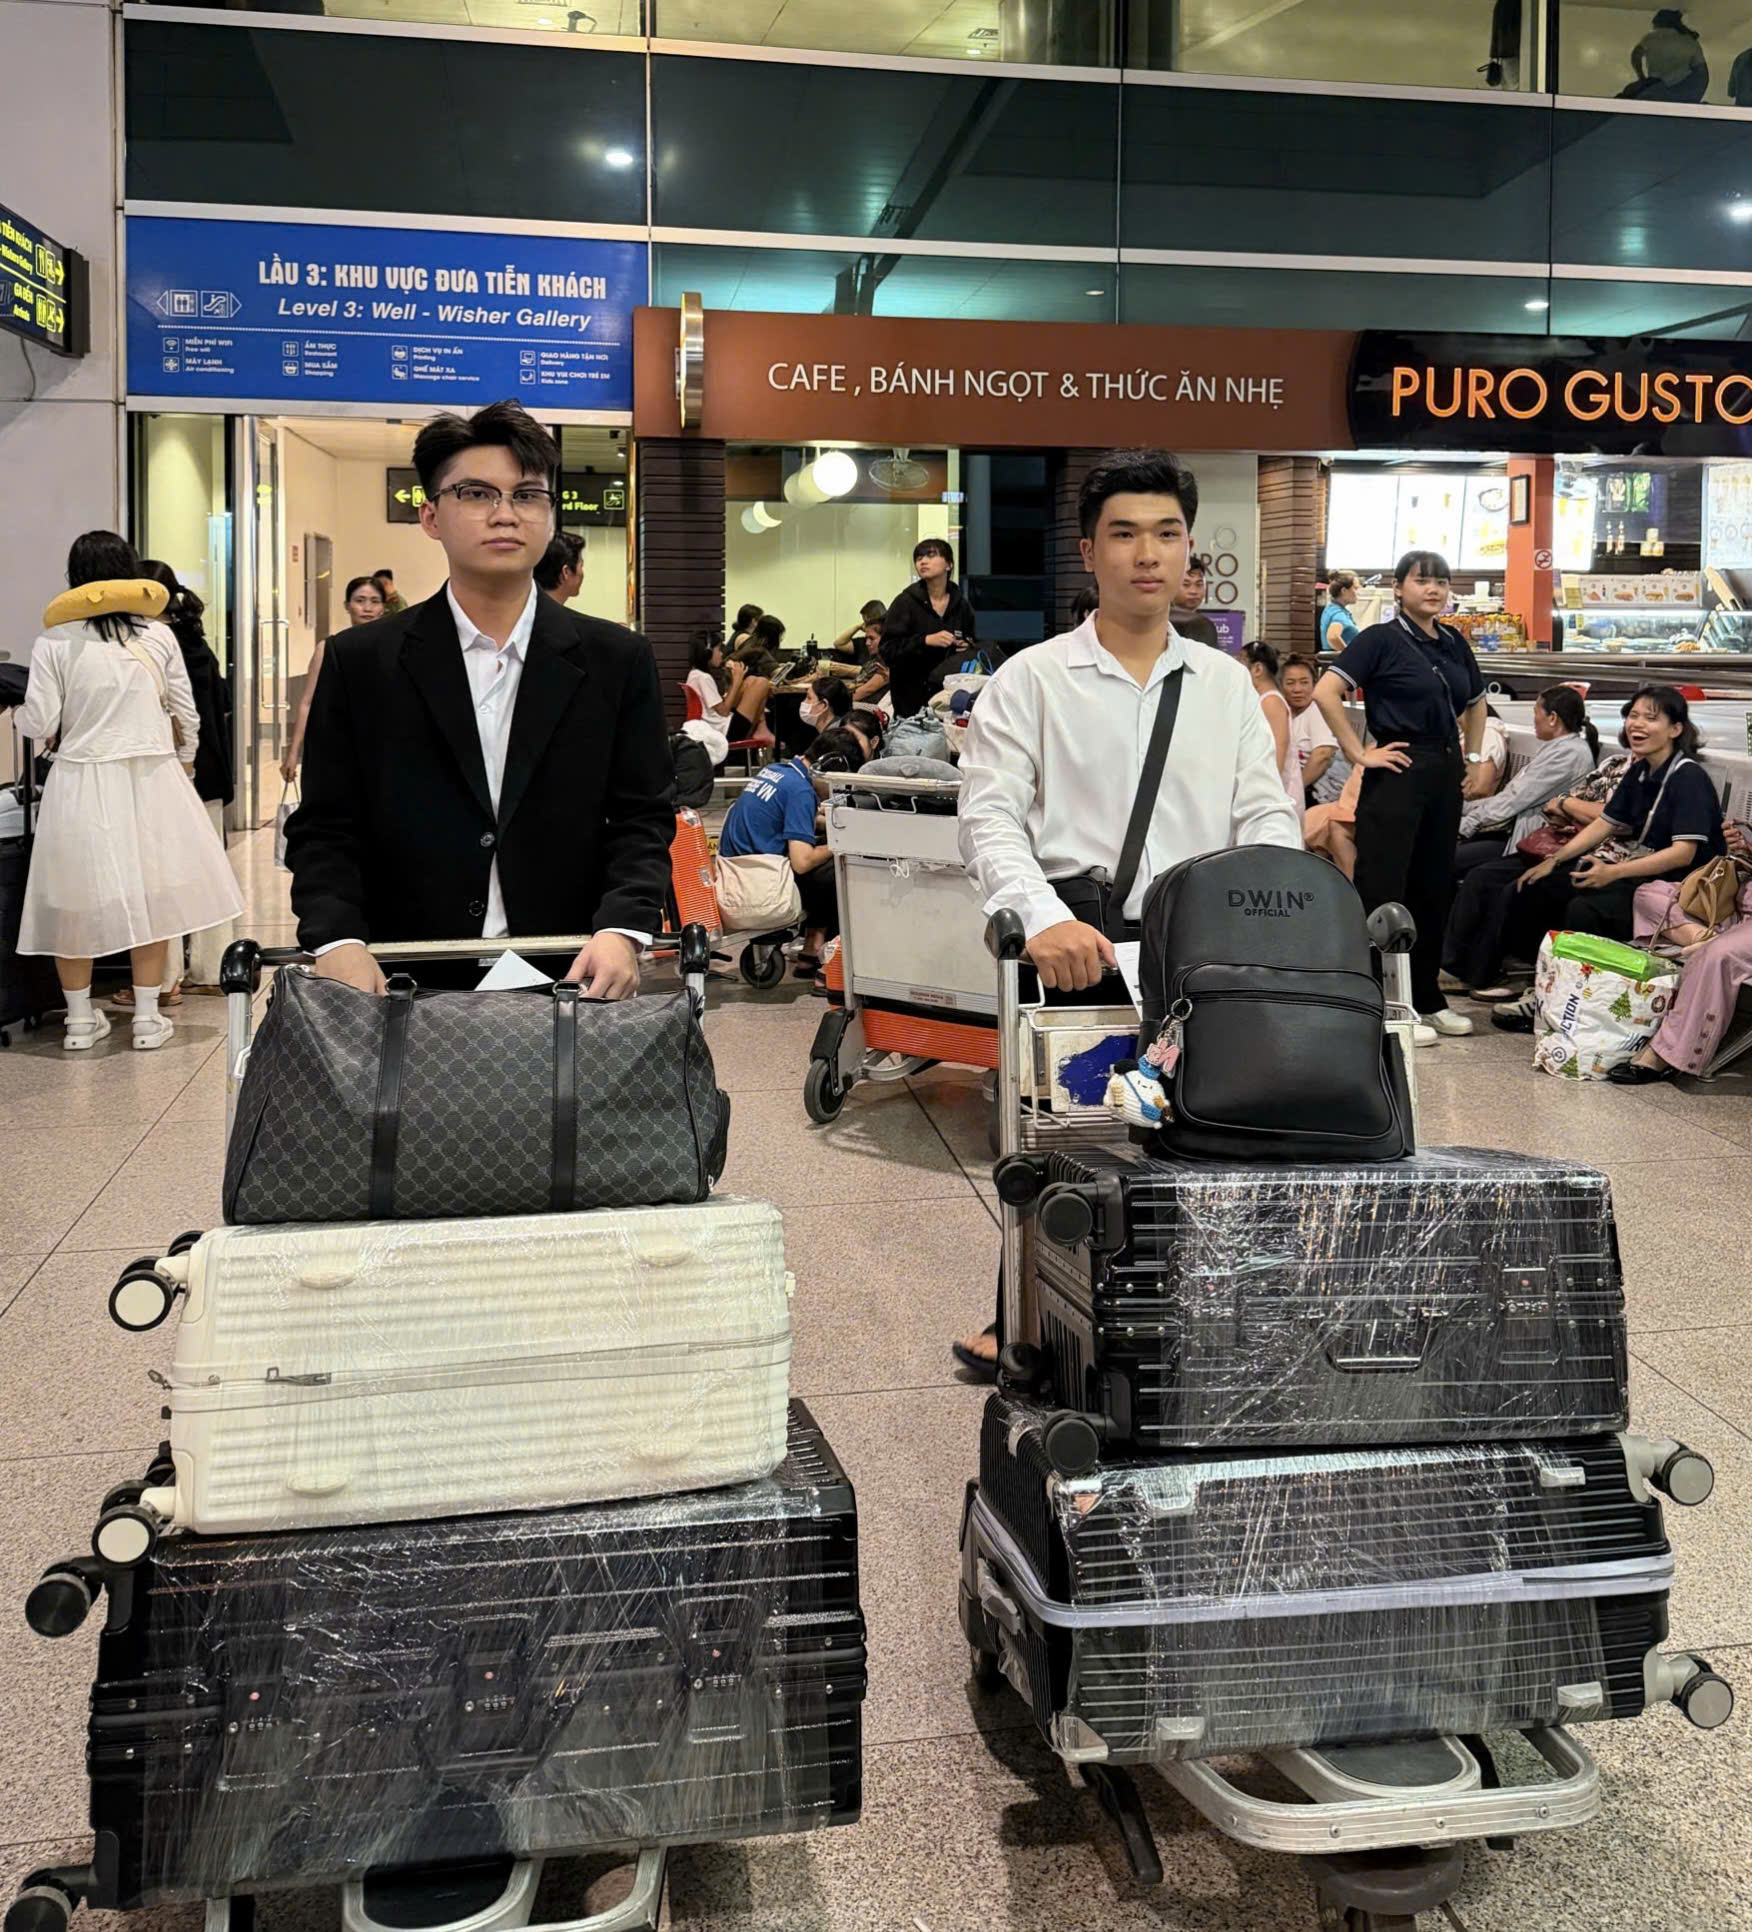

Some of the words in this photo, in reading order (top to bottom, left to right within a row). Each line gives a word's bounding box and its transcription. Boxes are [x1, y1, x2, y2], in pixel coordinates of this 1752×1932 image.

[259, 252, 299, 285] LẦU
[306, 263, 328, 287] 3:
[335, 264, 378, 289] KHU
[385, 266, 428, 295] VỰC
[435, 268, 479, 293] ĐƯA
[485, 264, 530, 296] TIỄN
[537, 271, 606, 299] KHÁCH
[278, 298, 338, 317] Level
[343, 301, 364, 318] 3:
[372, 302, 417, 321] Well
[437, 305, 511, 324] Wisher
[516, 308, 592, 332] Gallery
[540, 351, 559, 359] GIAO
[767, 362, 846, 391] CAFE
[870, 361, 954, 395] BÁNH
[964, 370, 1049, 402] NGỌT
[1059, 373, 1080, 398] &
[1085, 368, 1168, 400] THỨC
[1175, 370, 1216, 402] ĂN
[1225, 376, 1284, 410] NHẸ
[1392, 366, 1548, 419] PURO
[1564, 370, 1752, 425] GUSTO
[574, 501, 599, 511] Floor
[1200, 553, 1239, 577] RO
[1205, 581, 1239, 605] TO
[1244, 908, 1291, 918] OFFICIAL
